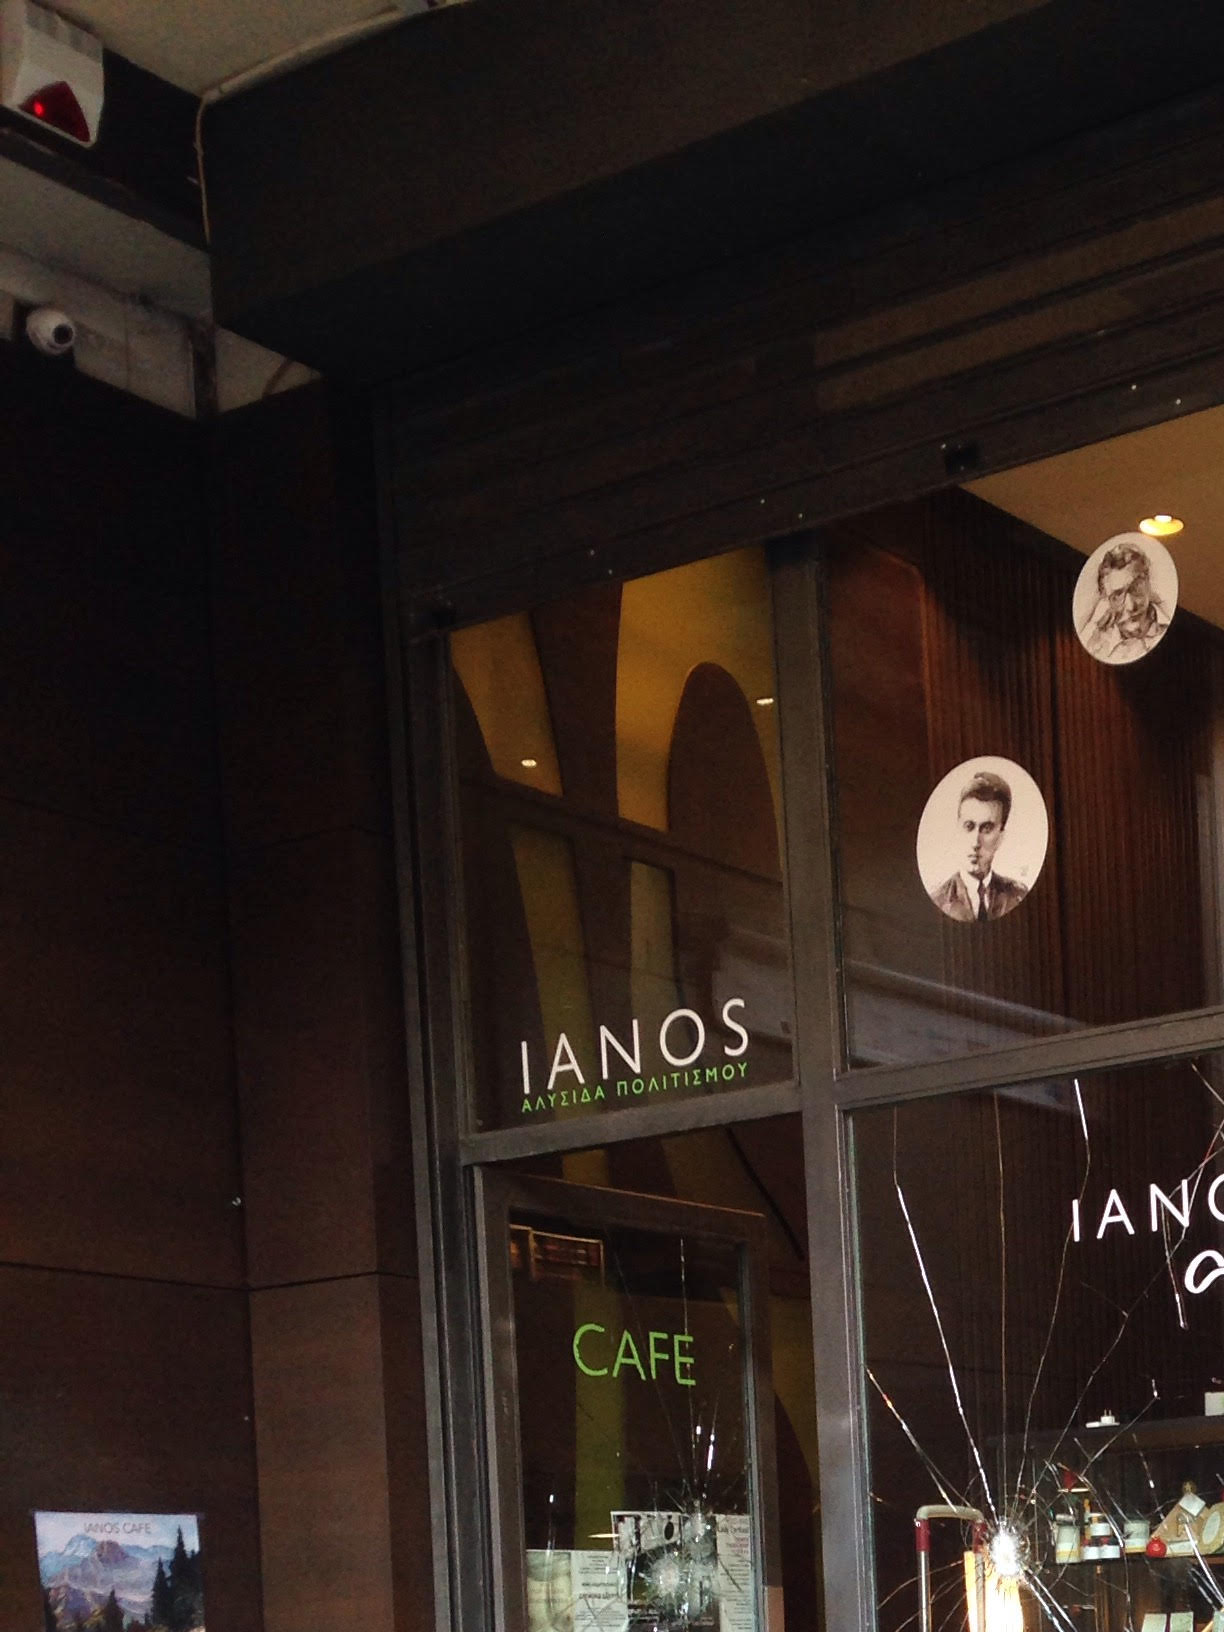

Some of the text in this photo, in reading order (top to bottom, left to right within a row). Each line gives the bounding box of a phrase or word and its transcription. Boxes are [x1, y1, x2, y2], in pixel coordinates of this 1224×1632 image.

[521, 998, 749, 1095] IANOS
[521, 1062, 749, 1113] ΑΛΥΣΙΔΑ ΠΟΛΙΤΙΣΜΟΥ
[573, 1323, 696, 1386] CAFE
[123, 1521, 152, 1535] CAFE
